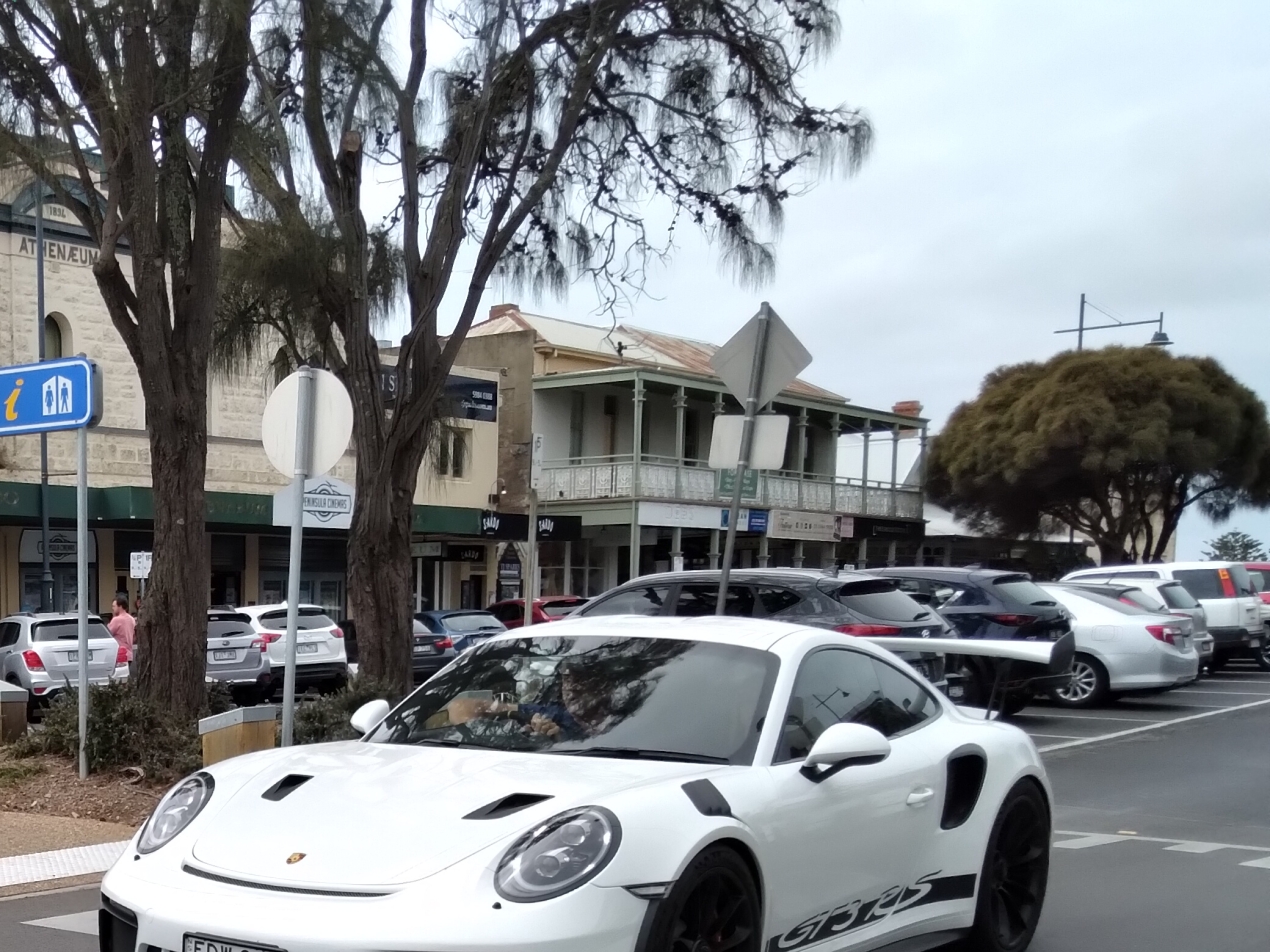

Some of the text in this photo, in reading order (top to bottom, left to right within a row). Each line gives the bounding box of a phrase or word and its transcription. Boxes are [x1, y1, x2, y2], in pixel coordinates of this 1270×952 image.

[303, 496, 347, 509] ENINSULA CINEMAS
[778, 870, 942, 948] GT3 RS
